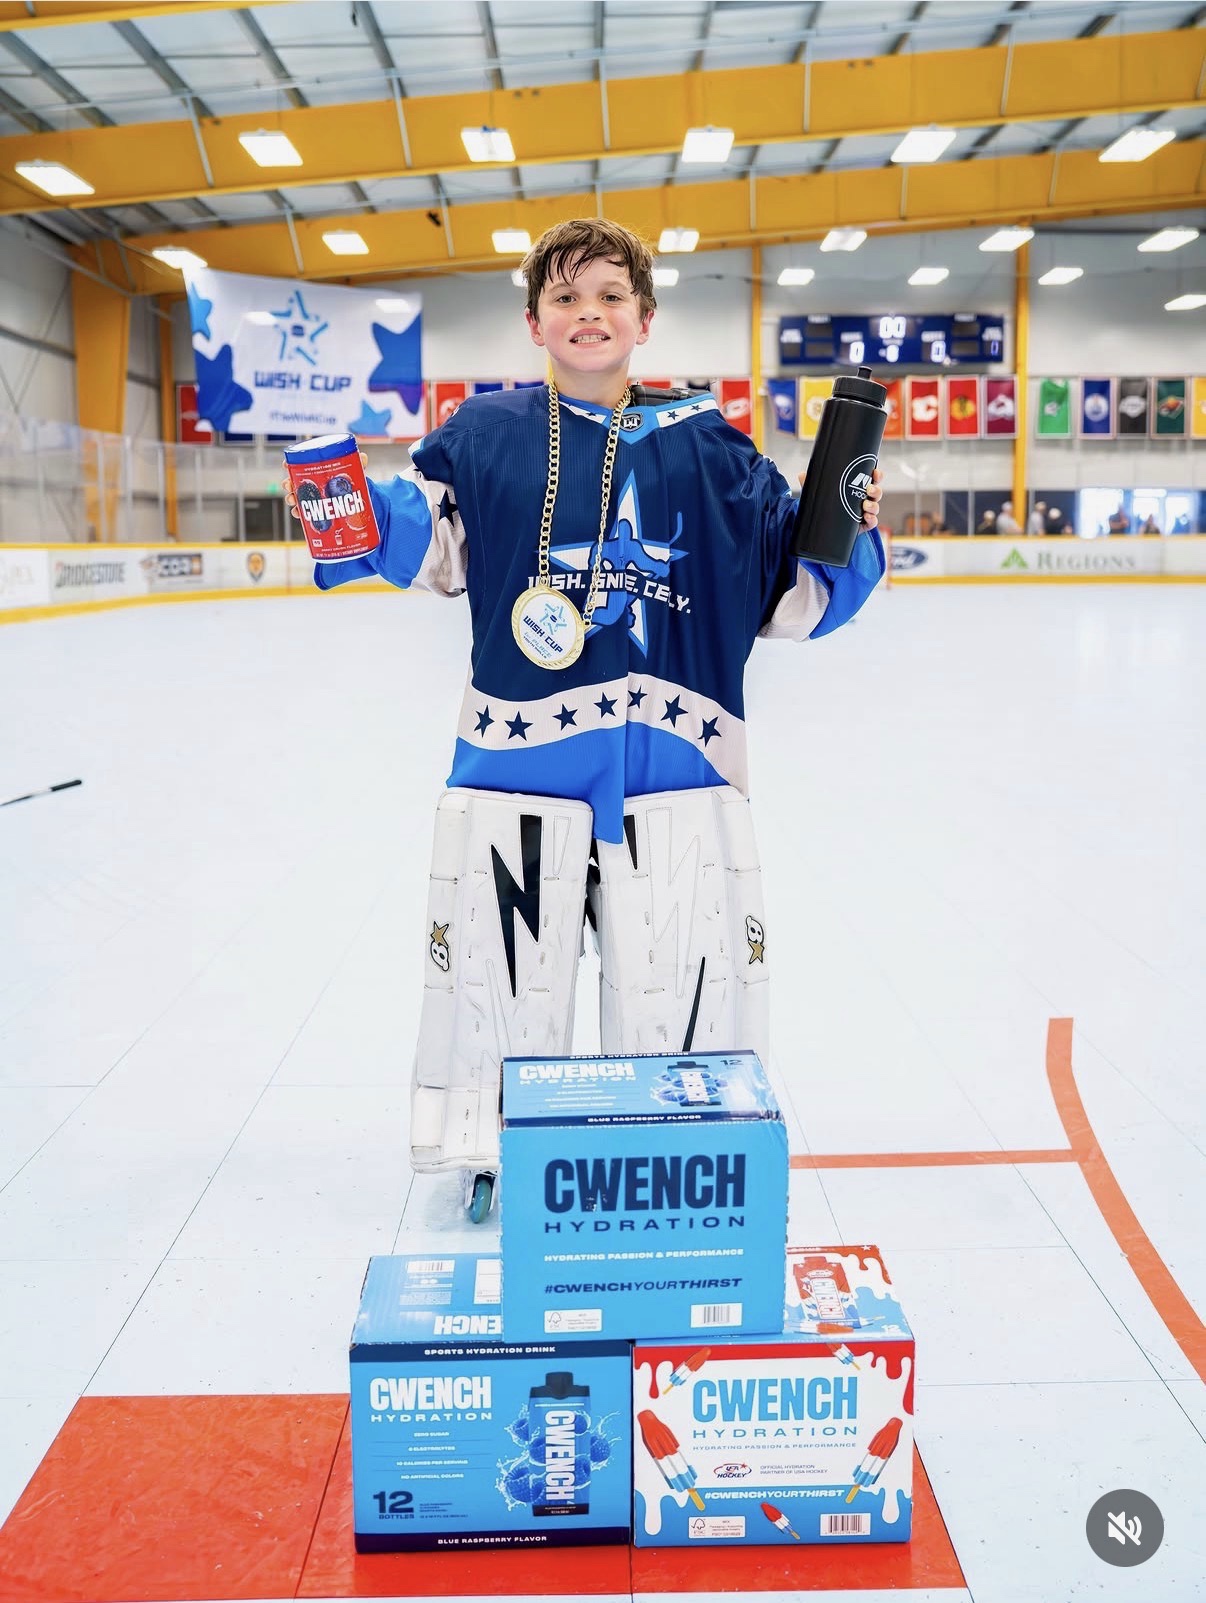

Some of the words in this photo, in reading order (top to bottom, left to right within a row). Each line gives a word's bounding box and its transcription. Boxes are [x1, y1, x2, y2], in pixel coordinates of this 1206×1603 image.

[879, 316, 906, 339] 00
[849, 341, 864, 363] 0
[931, 340, 946, 362] 0
[254, 371, 301, 389] WISH
[310, 374, 352, 393] CUP
[300, 490, 365, 521] CWENCH
[593, 572, 639, 593] GNIE.
[643, 580, 691, 614] CELY.
[523, 616, 545, 637] WISH
[545, 636, 563, 653] CUP
[519, 1063, 636, 1080] CWENCH
[719, 1058, 744, 1066] 12
[520, 1076, 636, 1085] HYDRATION
[544, 1153, 746, 1214] CWENCH
[544, 1216, 745, 1233] HYDRATION
[544, 1254, 605, 1262] HYDRATING
[608, 1252, 653, 1260] PASSION
[655, 1251, 664, 1259] &
[666, 1249, 744, 1258] PERFORMANCE
[544, 1278, 743, 1294] #CWENCHYOURTHIRST
[433, 1315, 502, 1335] ENCH
[370, 1376, 491, 1411] CWENCH
[692, 1376, 858, 1423] CWENCH
[370, 1412, 492, 1422] HYDRATION
[692, 1426, 857, 1439] HYDRATION
[545, 1410, 575, 1500] CWENCH
[373, 1491, 414, 1513] 12
[704, 1489, 845, 1500] #CWENCHYOURTHIRST
